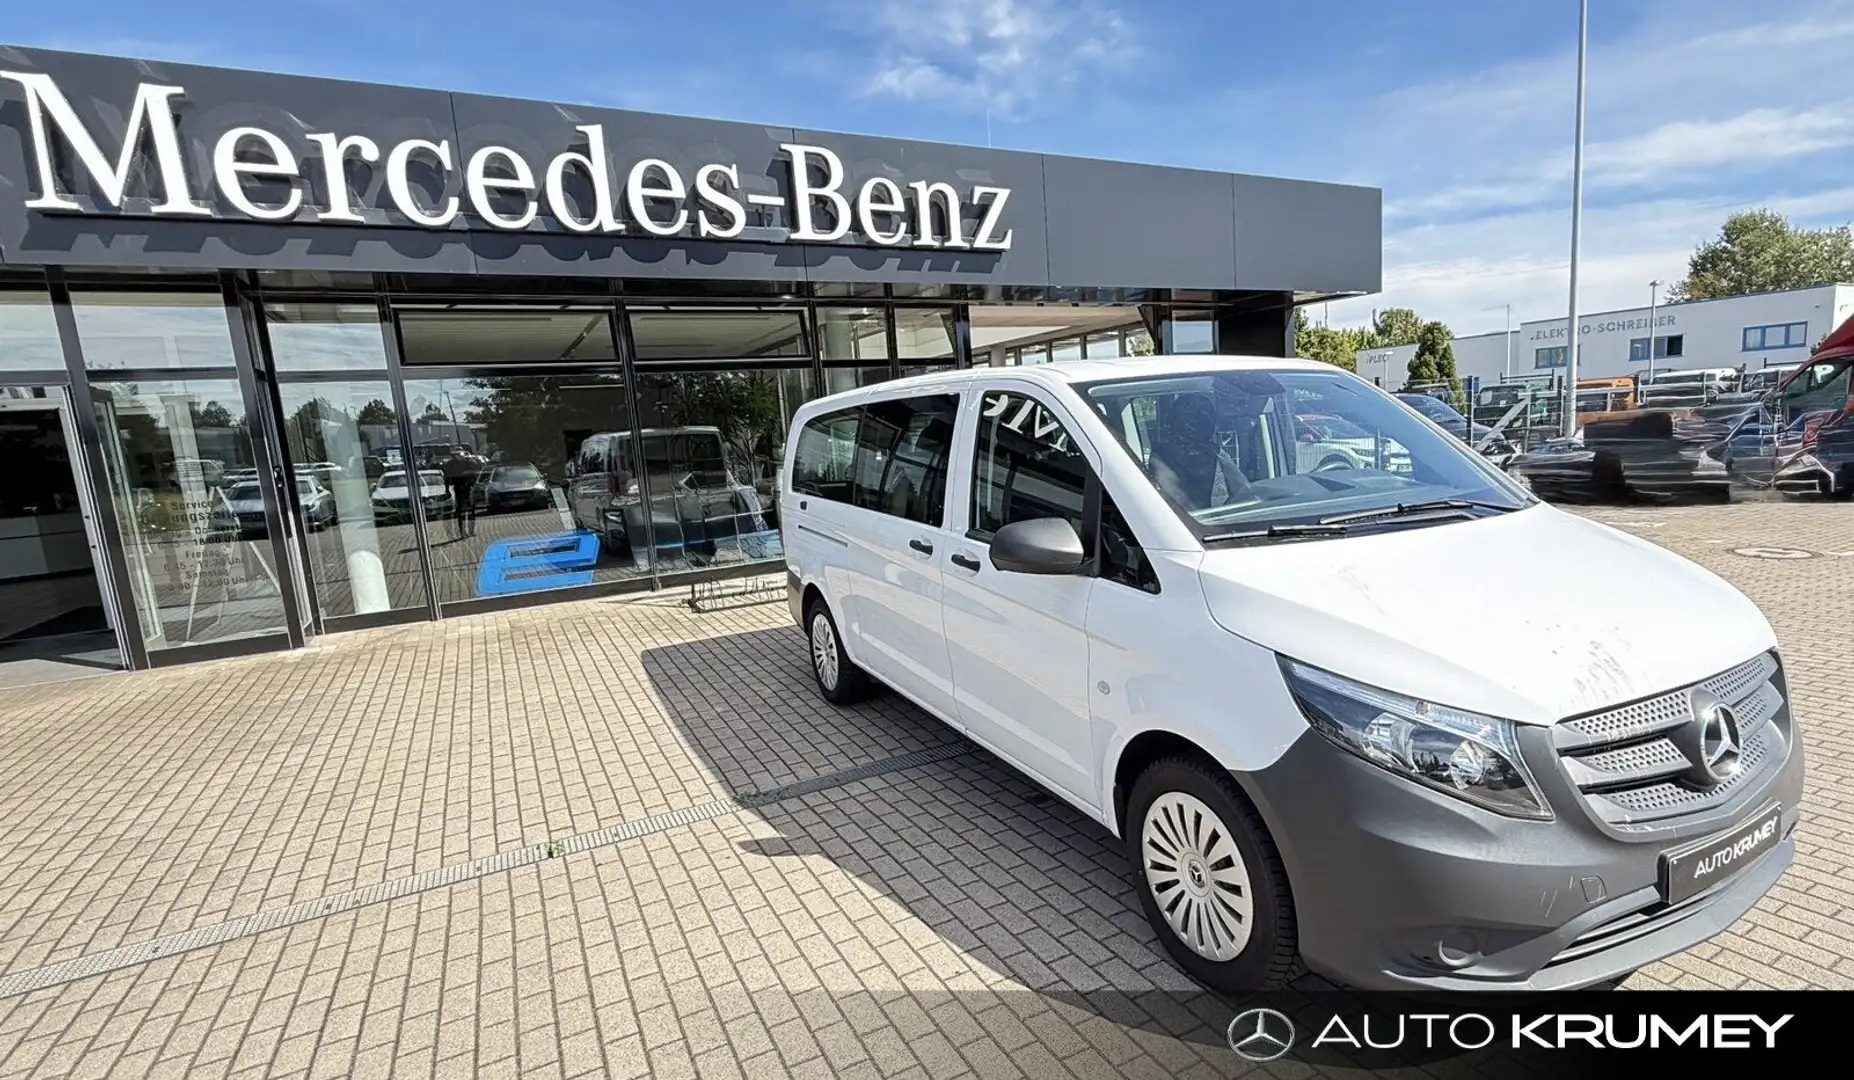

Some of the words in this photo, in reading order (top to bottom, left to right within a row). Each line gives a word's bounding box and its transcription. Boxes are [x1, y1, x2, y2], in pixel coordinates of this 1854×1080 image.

[0, 70, 1013, 252] Mercedes-Benz
[1694, 847, 1733, 879] AUTO
[1733, 816, 1778, 859] KRUMEY
